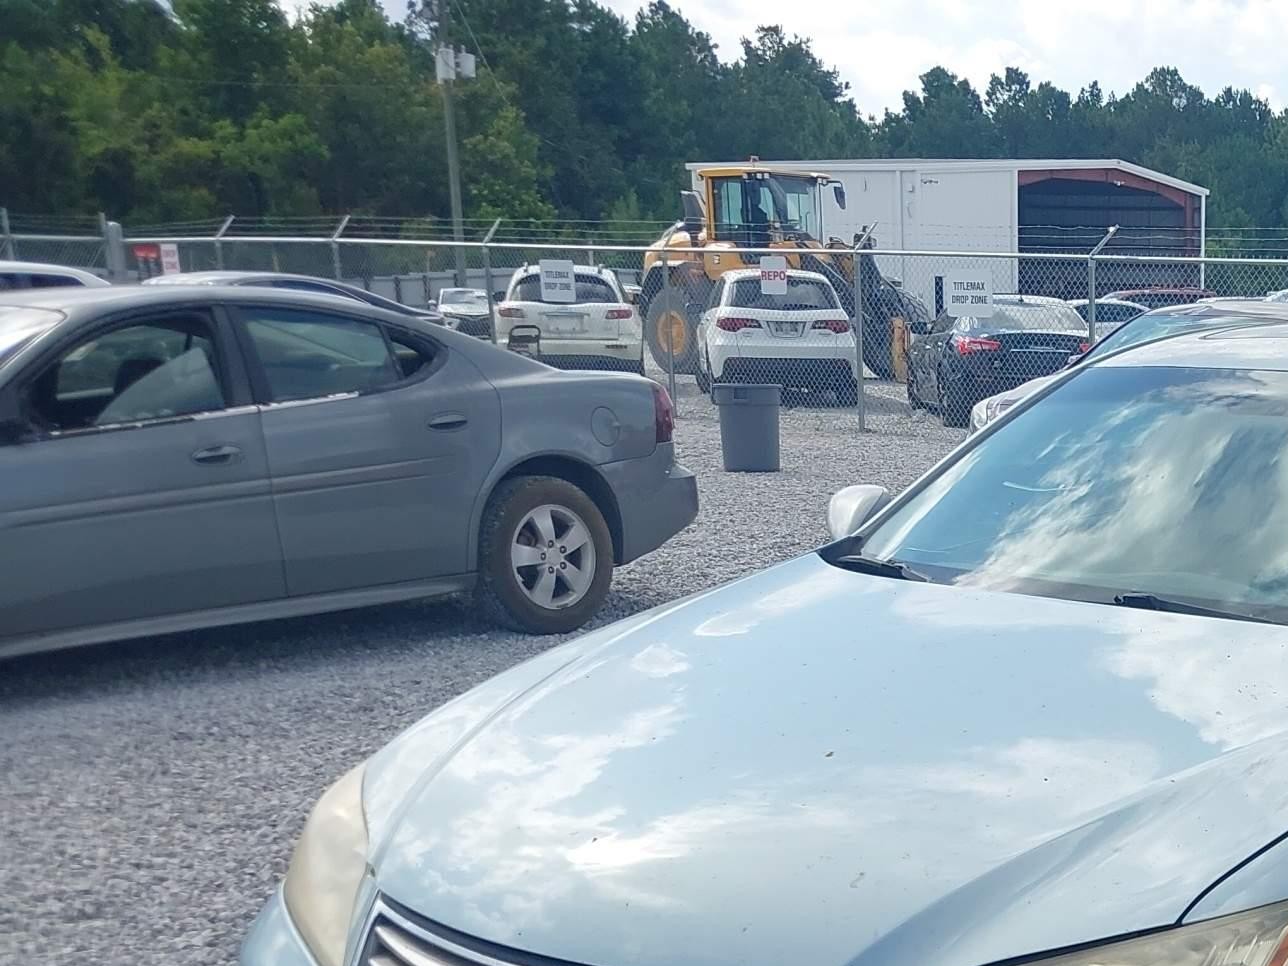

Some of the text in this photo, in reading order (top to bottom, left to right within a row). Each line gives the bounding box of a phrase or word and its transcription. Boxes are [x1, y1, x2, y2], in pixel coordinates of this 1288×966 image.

[761, 271, 785, 280] REPO
[953, 281, 985, 290] TITLEMAX
[951, 295, 988, 305] DROP ZONE
